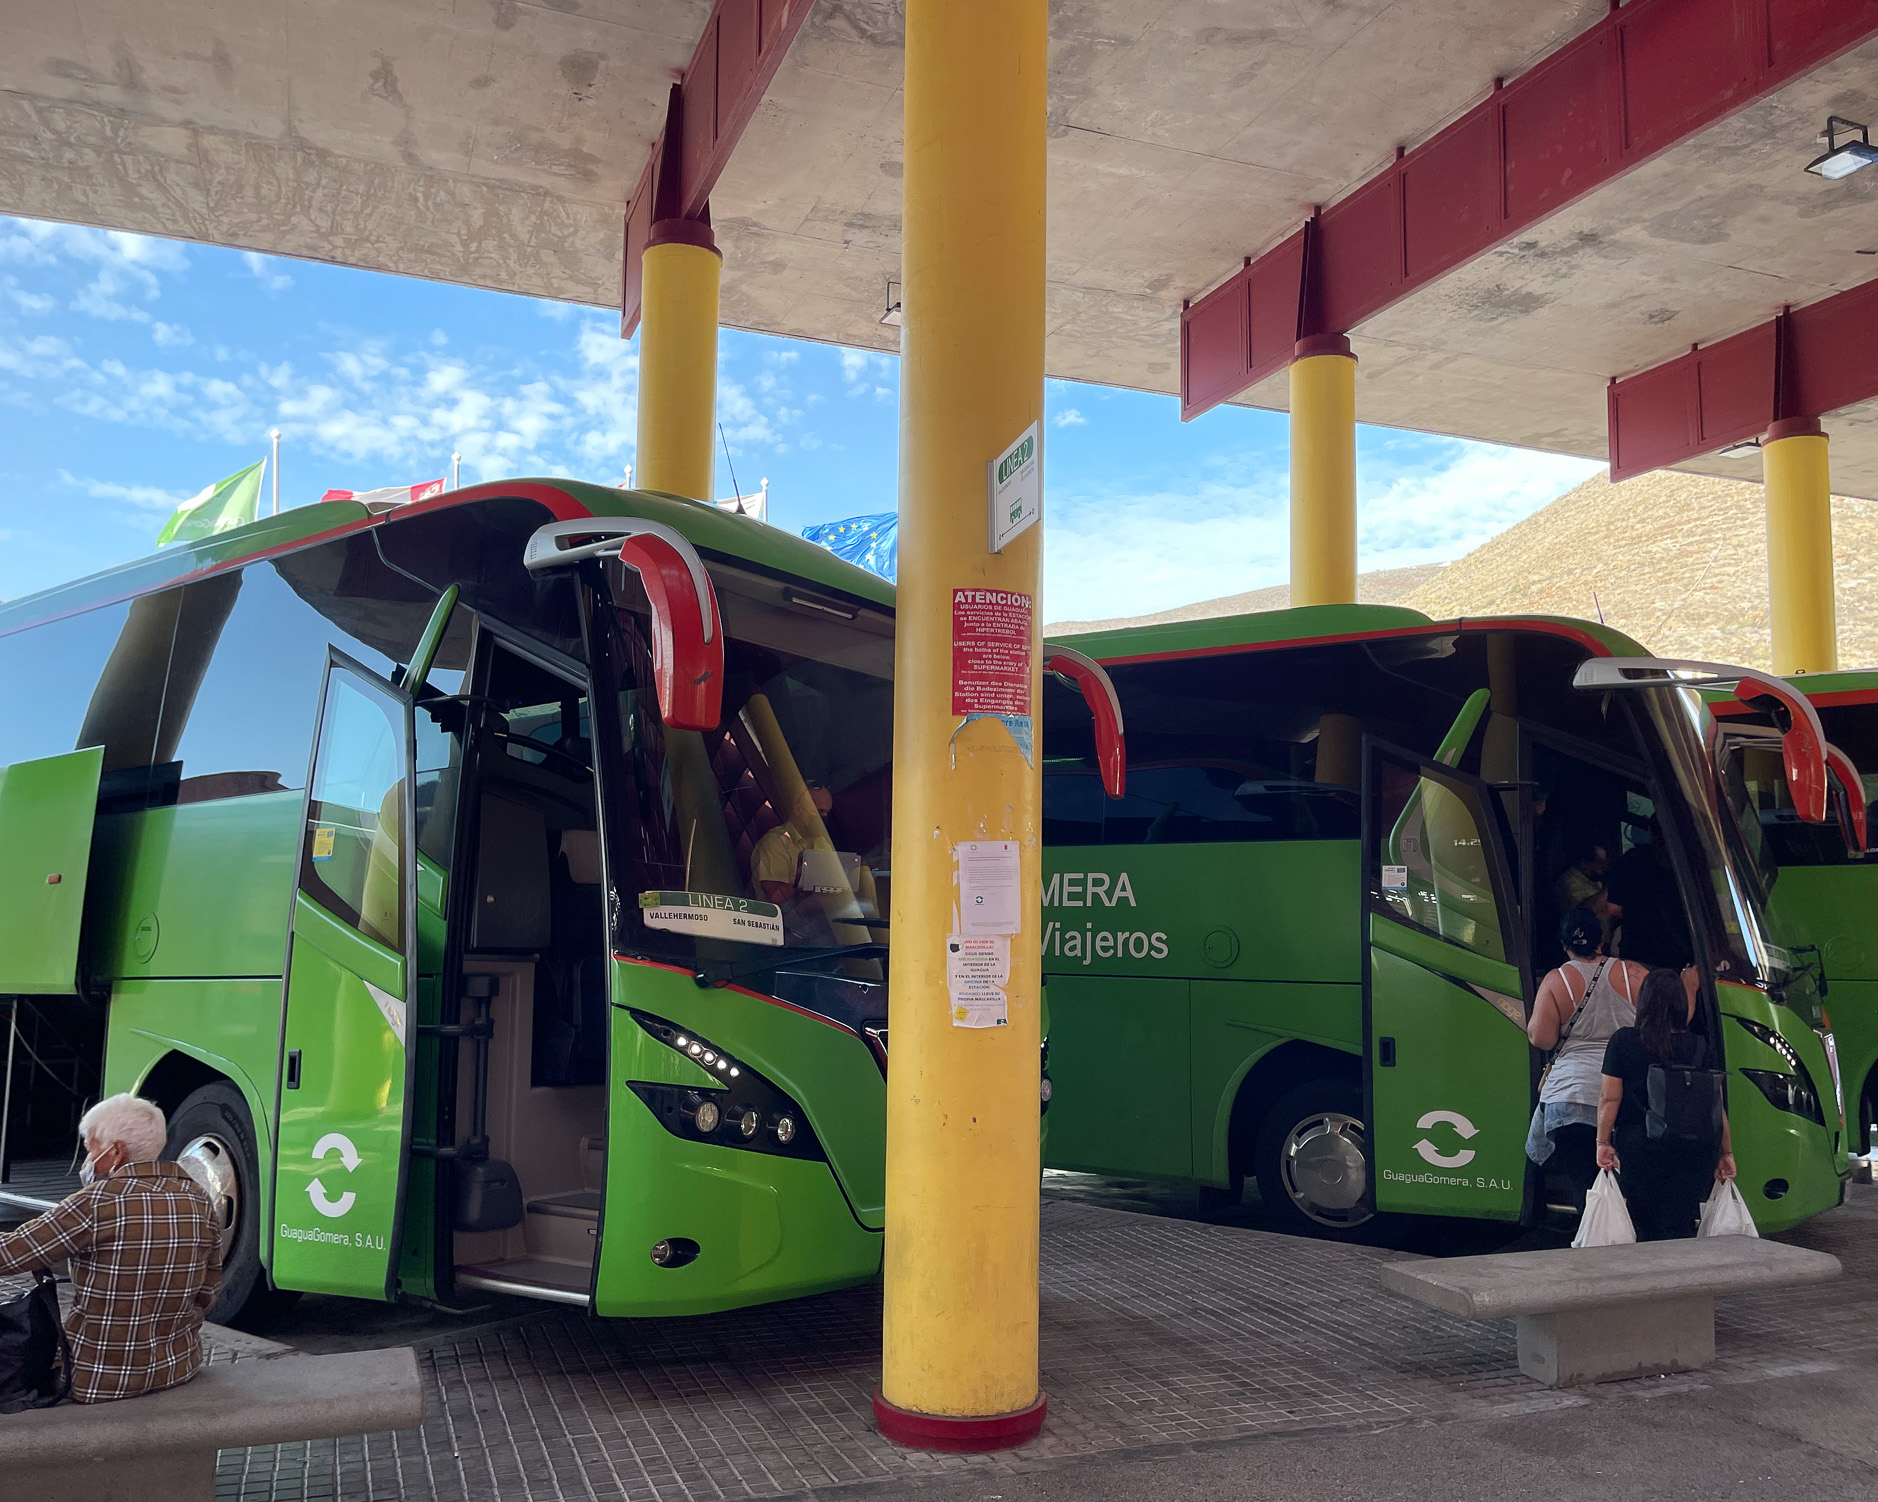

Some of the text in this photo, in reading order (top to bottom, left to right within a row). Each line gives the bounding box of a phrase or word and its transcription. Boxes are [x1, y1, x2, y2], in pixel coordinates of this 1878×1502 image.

[1002, 447, 1022, 480] LINEA
[1023, 441, 1028, 461] 2
[954, 591, 1032, 609] ATENCIÓN:
[688, 893, 749, 913] LINEA 2
[649, 912, 709, 922] VALLEHERMOSO
[732, 917, 746, 927] SAN
[1476, 1177, 1514, 1191] S.A.U.
[280, 1223, 386, 1251] GuaguaGomera, S.A.U.
